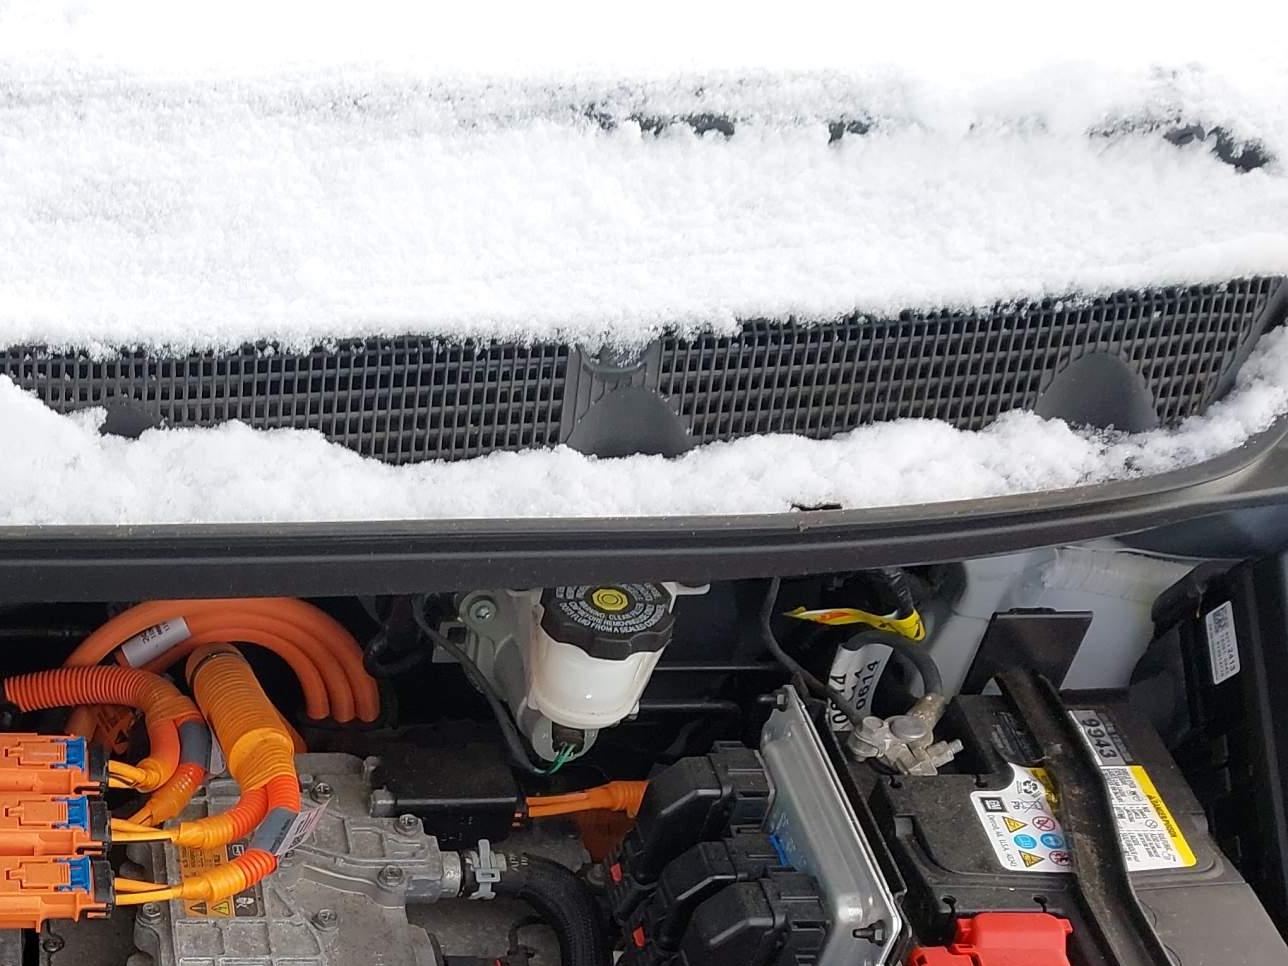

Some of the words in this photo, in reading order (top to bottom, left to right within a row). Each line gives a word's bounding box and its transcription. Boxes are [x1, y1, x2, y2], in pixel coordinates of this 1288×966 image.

[591, 623, 612, 632] FROM
[855, 660, 881, 710] 0614
[1082, 718, 1117, 759] 9943
